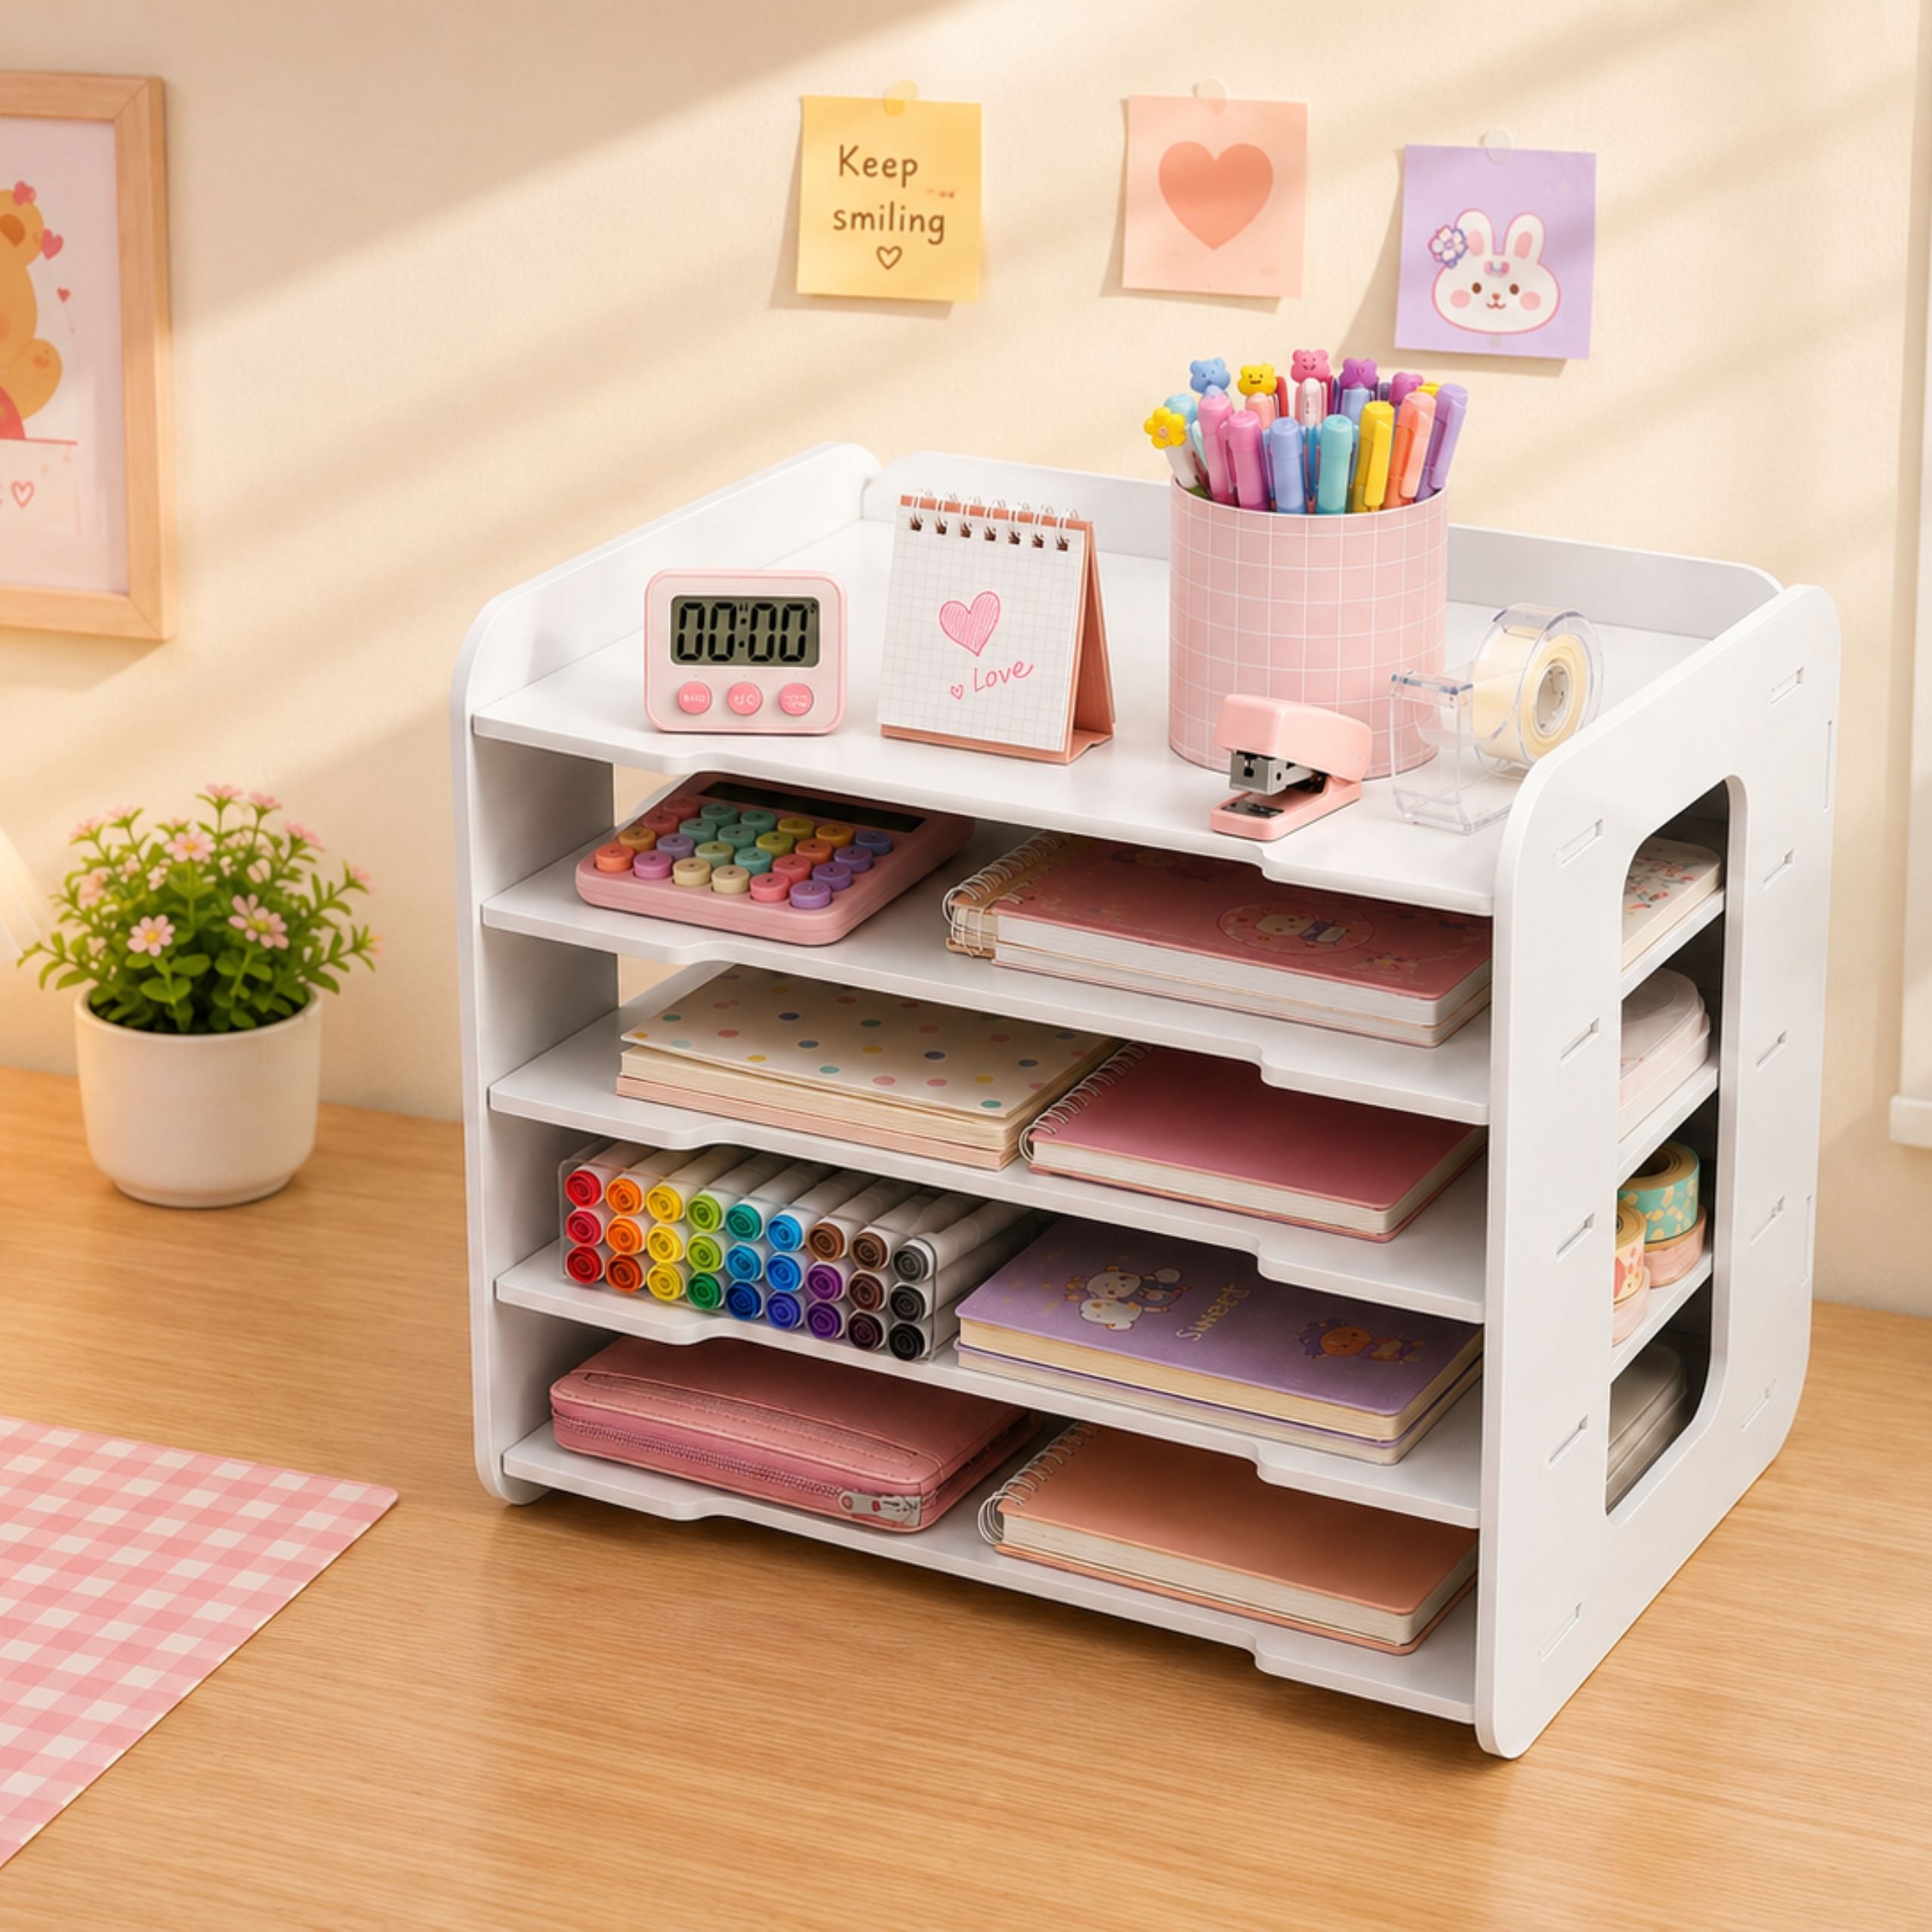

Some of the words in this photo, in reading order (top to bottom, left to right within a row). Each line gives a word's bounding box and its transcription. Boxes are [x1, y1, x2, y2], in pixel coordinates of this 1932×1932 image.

[838, 143, 919, 189] Keep
[833, 200, 946, 246] smiling
[677, 602, 808, 662] 00:00
[972, 660, 1034, 693] Love
